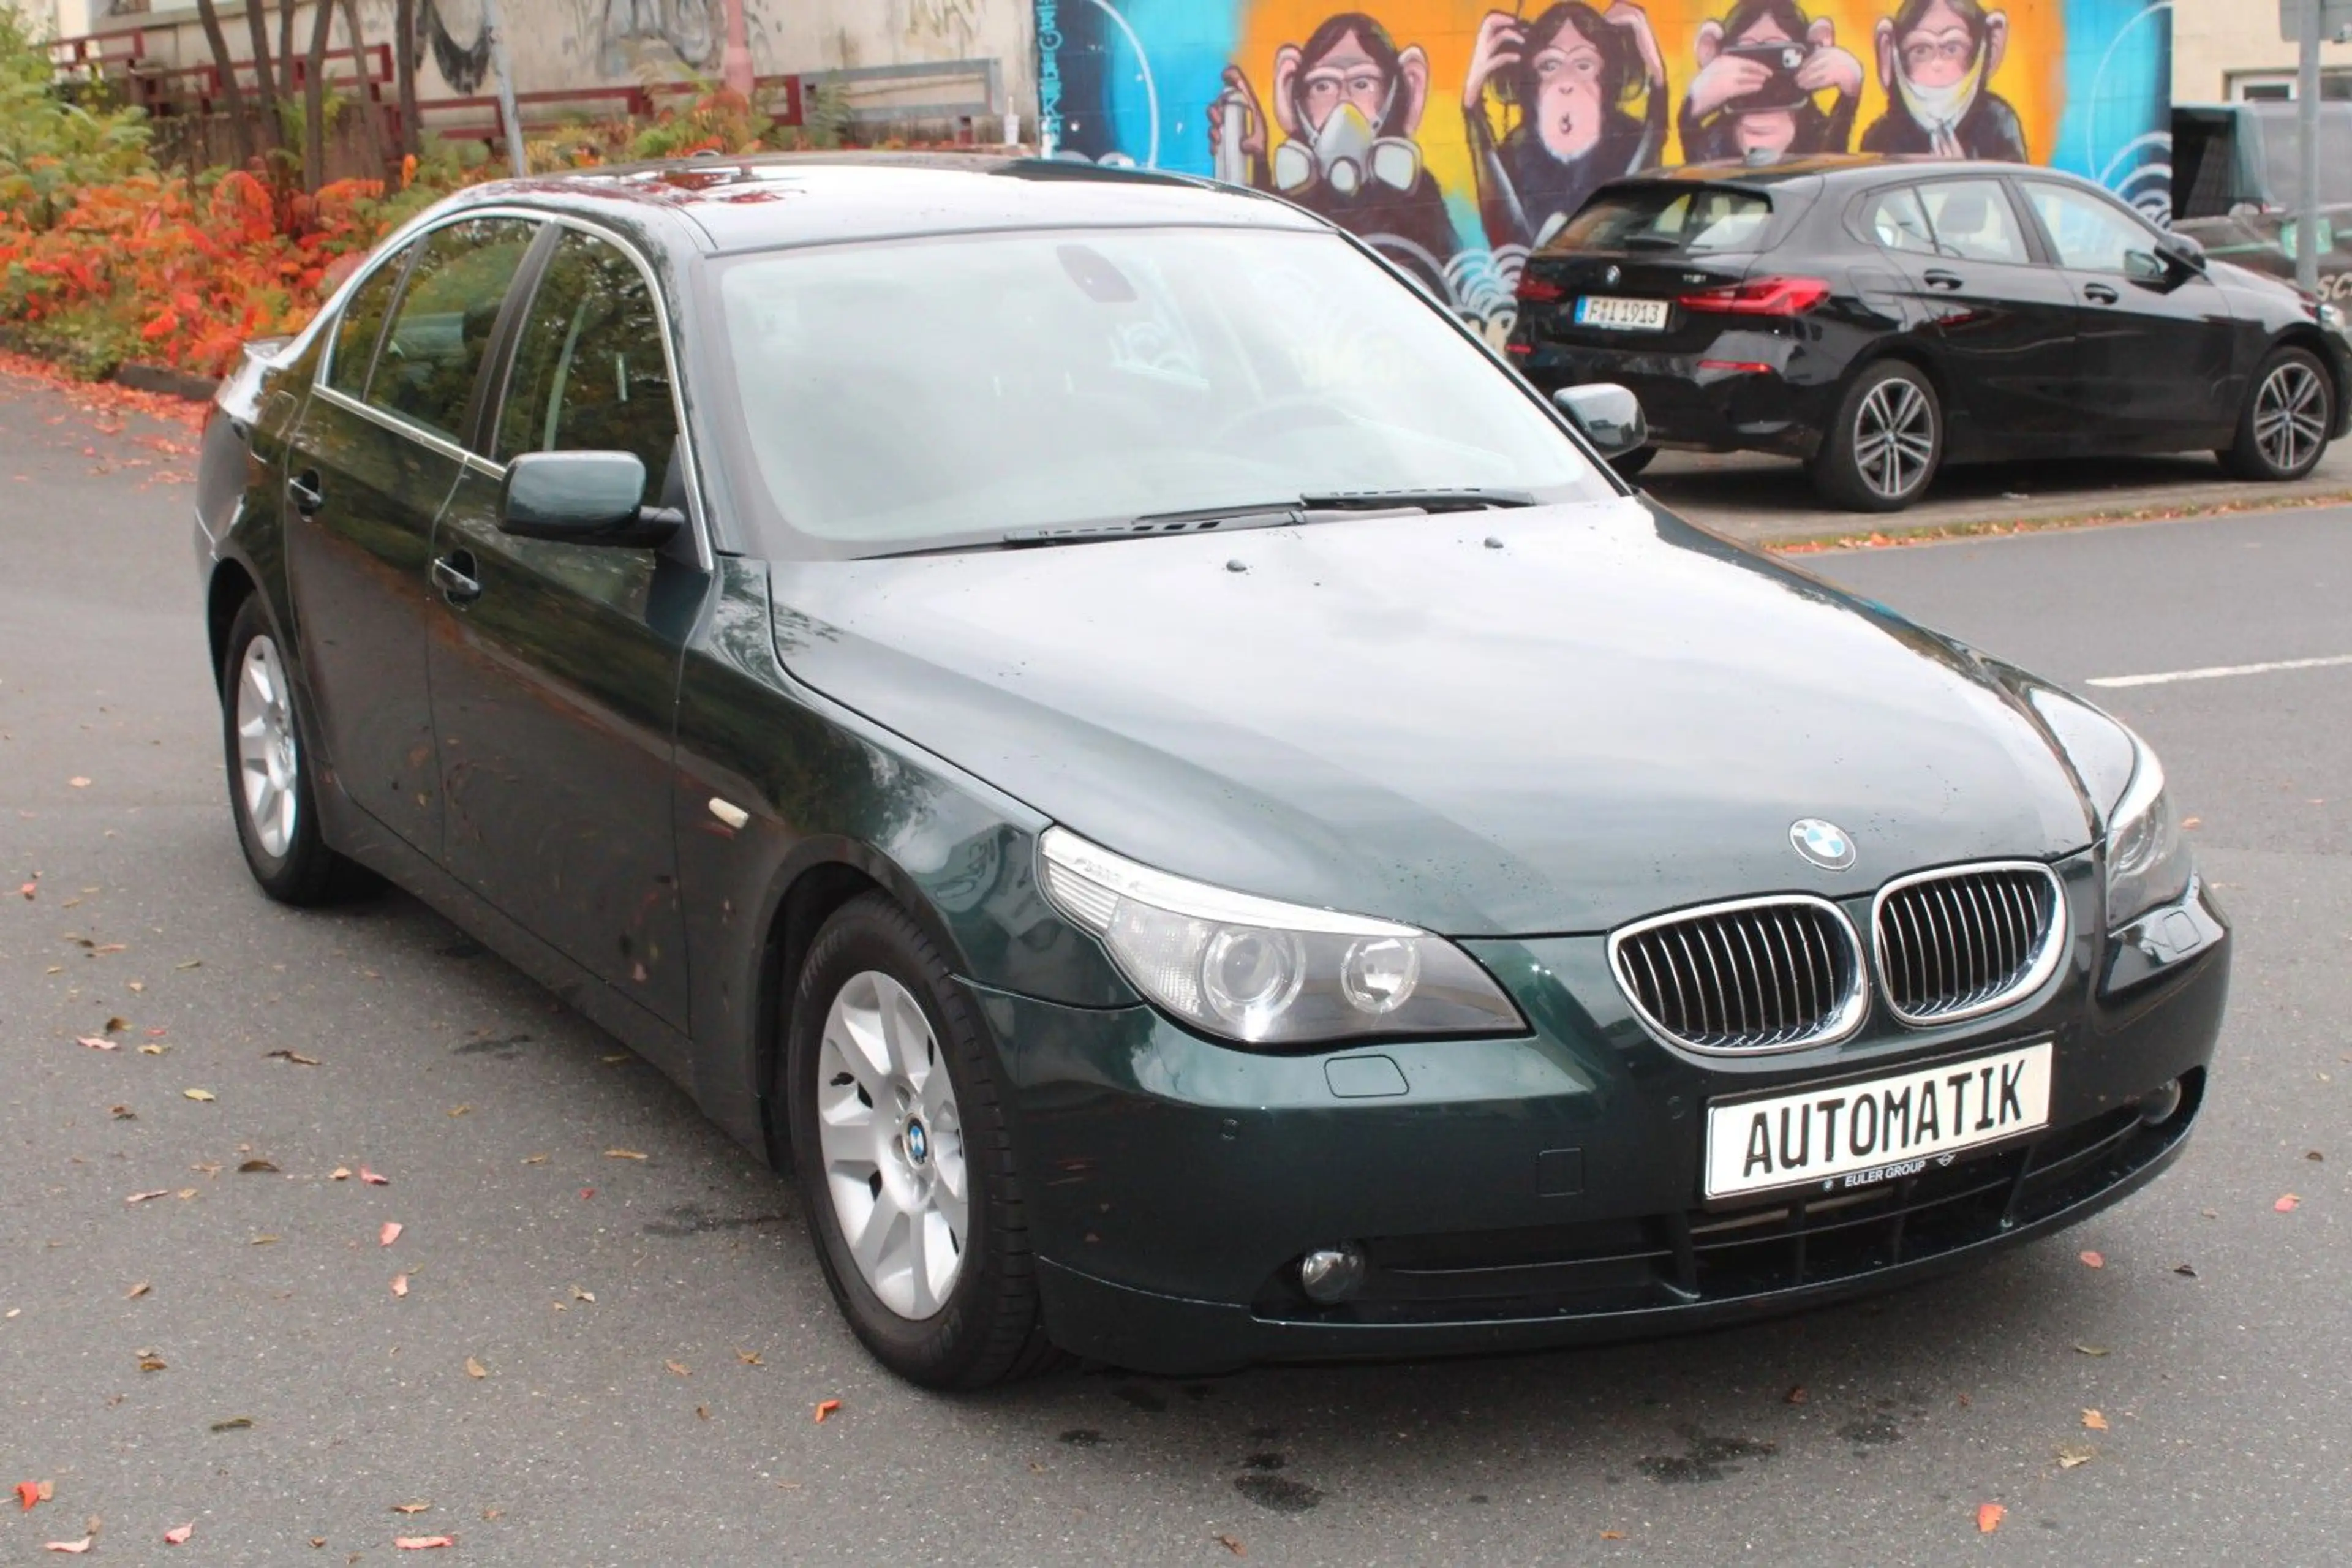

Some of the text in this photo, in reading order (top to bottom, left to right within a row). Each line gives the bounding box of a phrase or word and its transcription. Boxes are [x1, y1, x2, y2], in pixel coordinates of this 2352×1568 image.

[1743, 1059, 2026, 1177] AUTOMATIK
[1844, 1160, 1926, 1188] EULER GROUP
